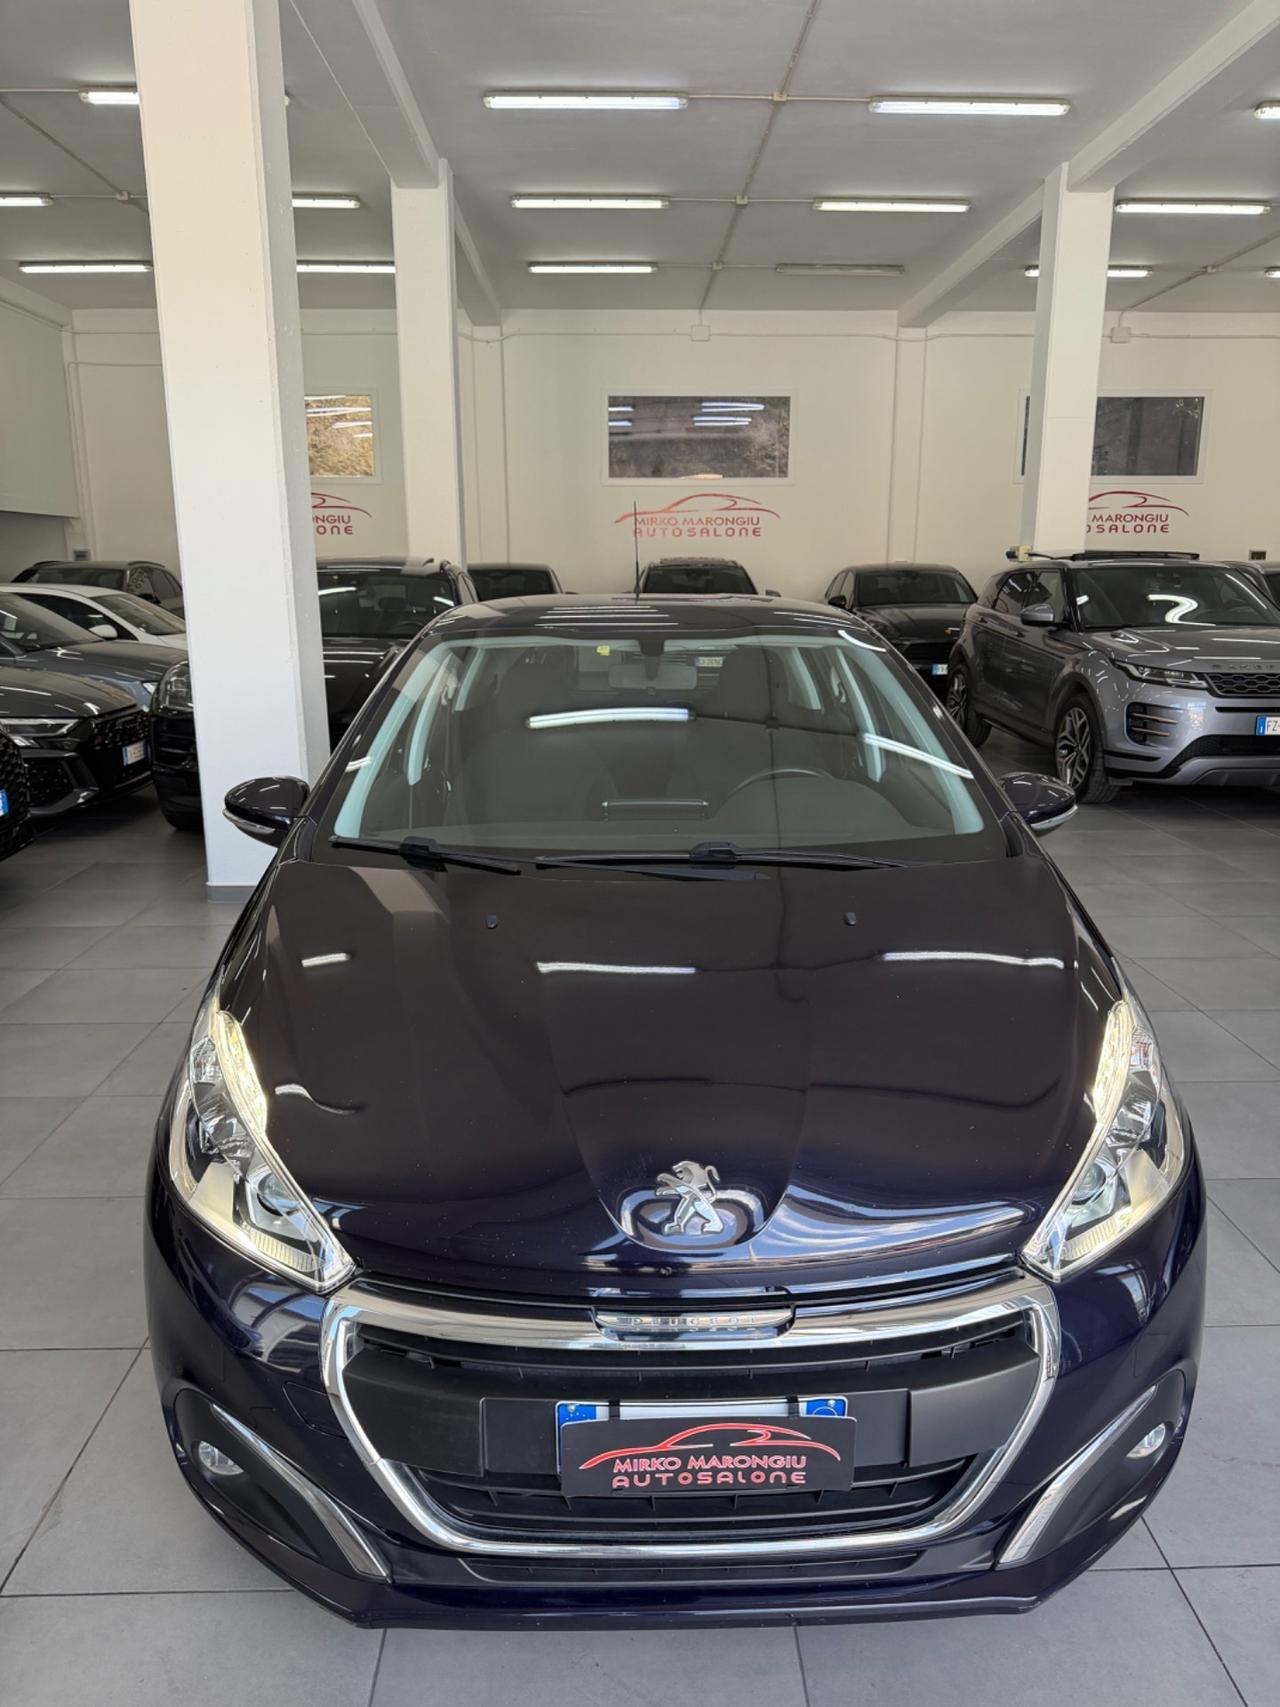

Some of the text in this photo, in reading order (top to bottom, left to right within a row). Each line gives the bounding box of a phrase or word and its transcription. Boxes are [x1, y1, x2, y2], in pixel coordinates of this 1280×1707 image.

[312, 514, 351, 524] NGIU
[635, 516, 760, 526] MIRKO MARONGIU
[1092, 513, 1169, 523] MARONGIU
[633, 527, 762, 537] AUTOSALONE
[613, 1455, 807, 1473] MIRKO MARONGIU
[612, 1471, 806, 1488] AUTOSALONE
